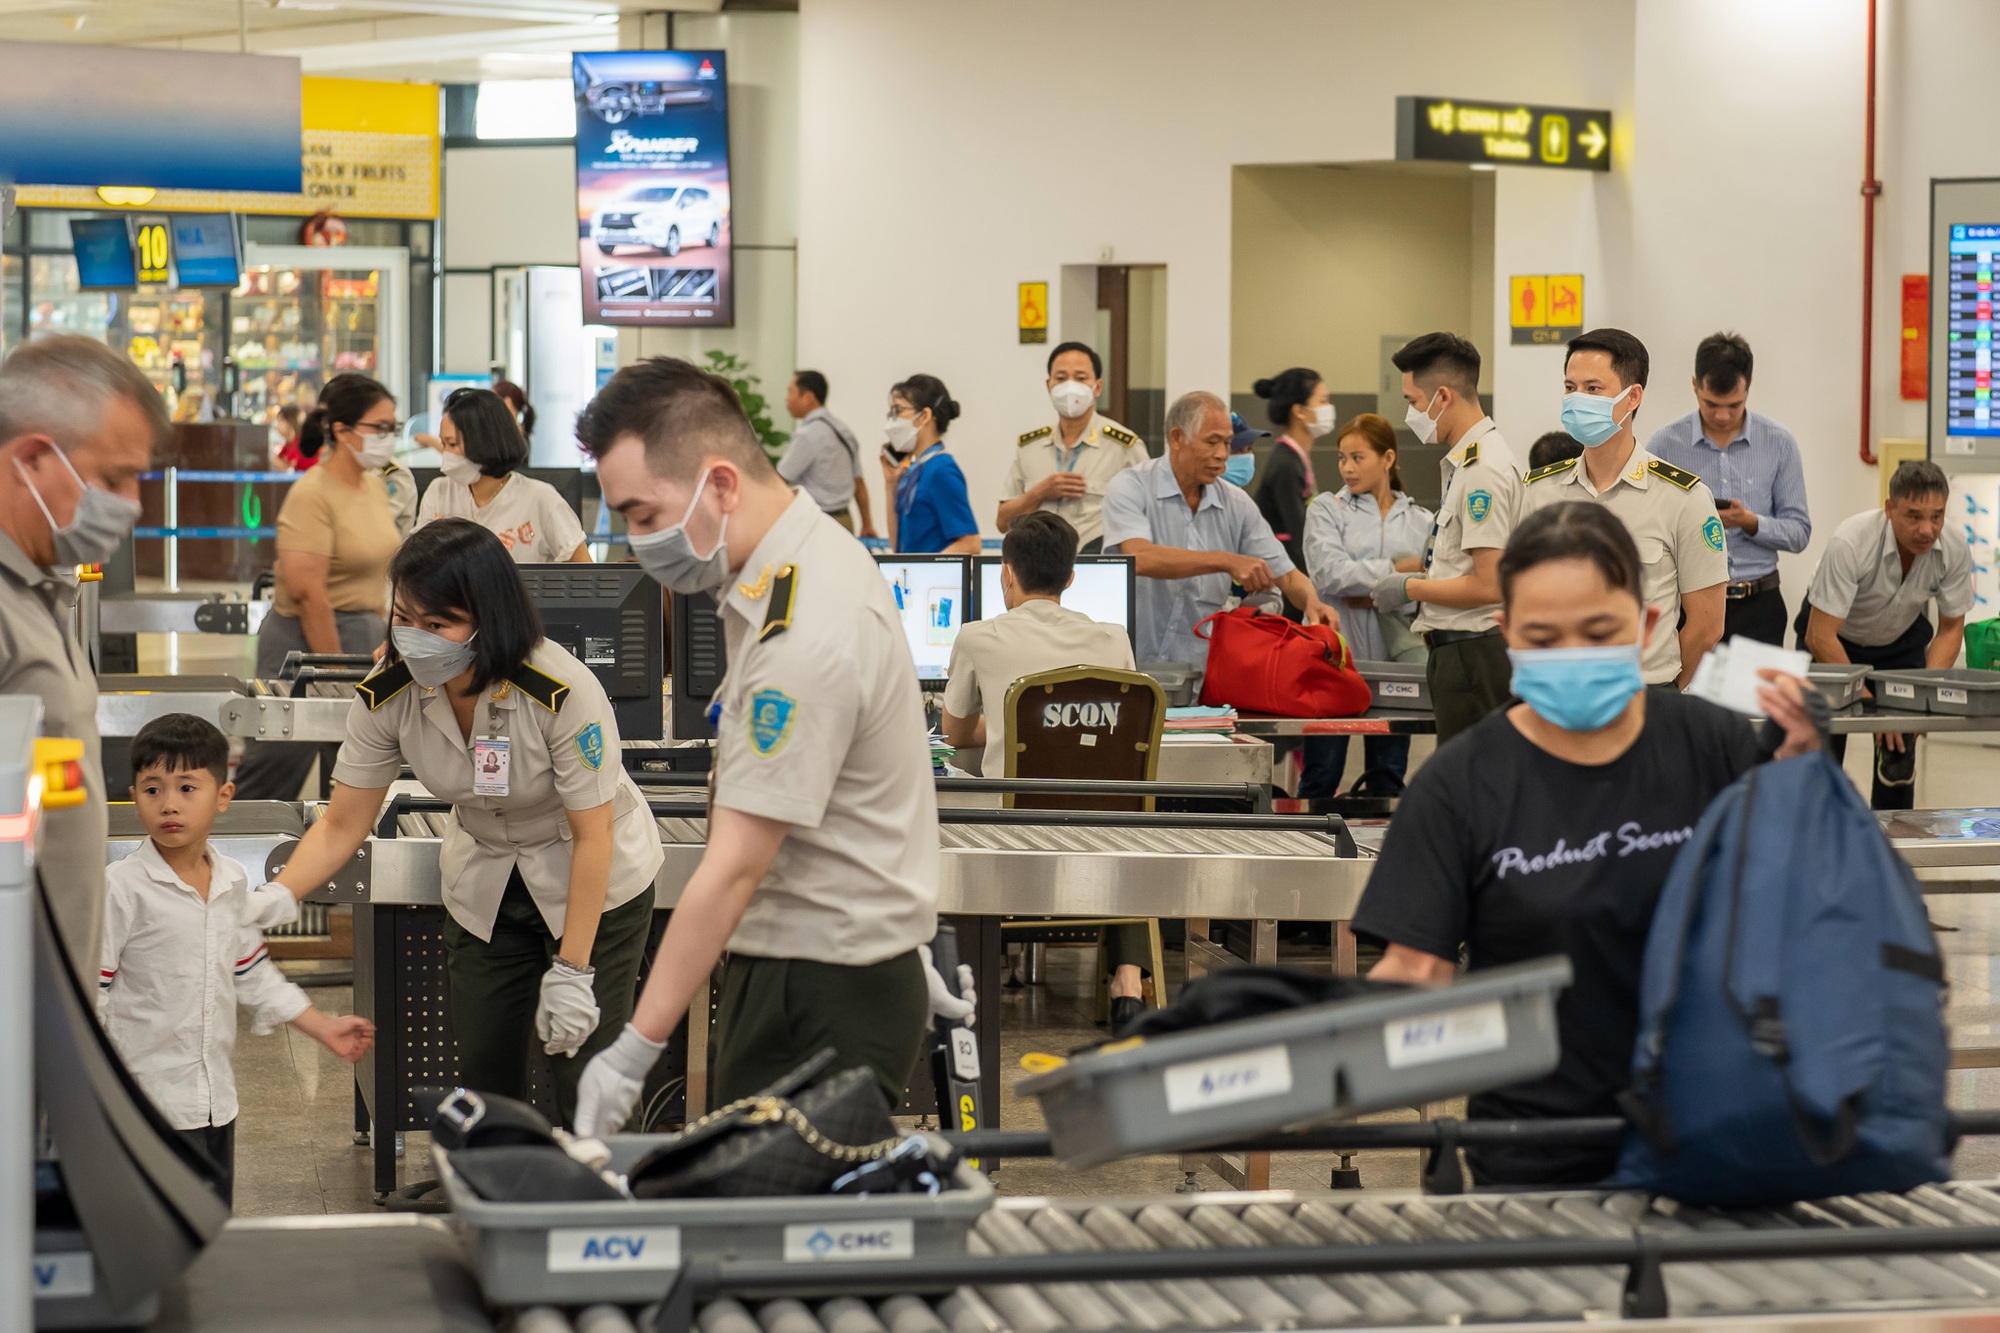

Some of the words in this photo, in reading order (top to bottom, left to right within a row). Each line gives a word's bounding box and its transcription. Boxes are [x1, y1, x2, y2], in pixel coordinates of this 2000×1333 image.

[137, 225, 168, 269] 10
[1395, 685, 1413, 693] CMC
[1492, 831, 1612, 879] Product
[581, 1236, 646, 1260] ACV
[838, 1231, 893, 1251] CMC
